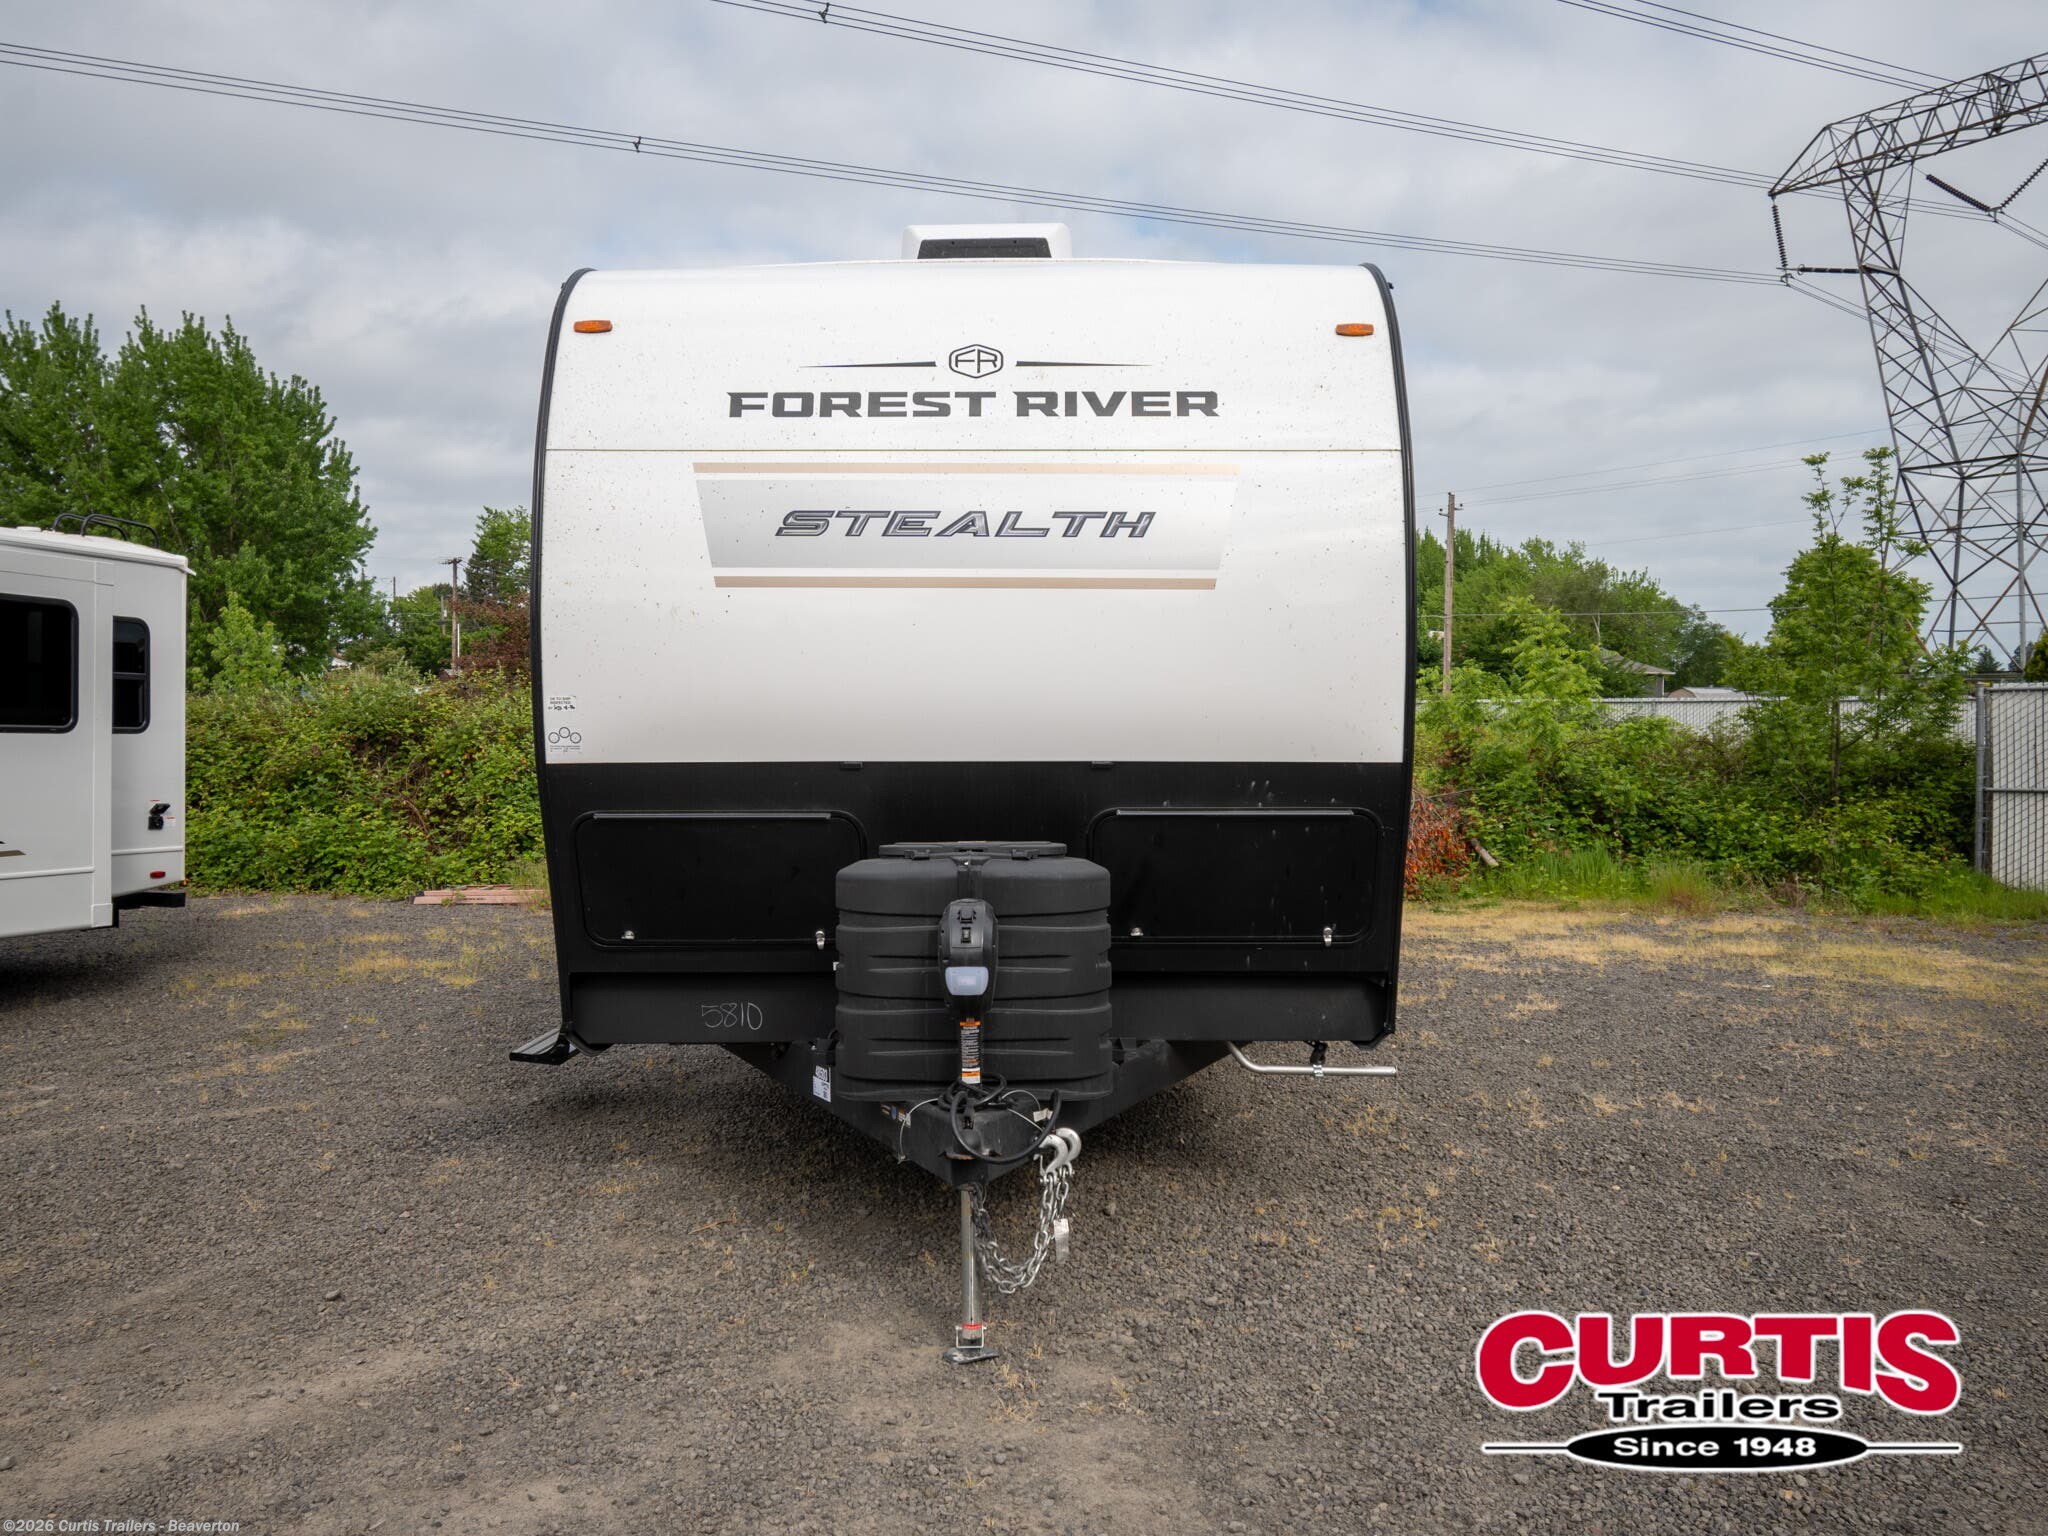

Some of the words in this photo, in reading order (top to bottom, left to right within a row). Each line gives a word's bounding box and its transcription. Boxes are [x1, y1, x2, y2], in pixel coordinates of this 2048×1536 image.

[726, 392, 996, 418] FOREST
[1012, 392, 1220, 418] RIVER
[775, 510, 1157, 538] STEALTH
[700, 1001, 763, 1031] 5810
